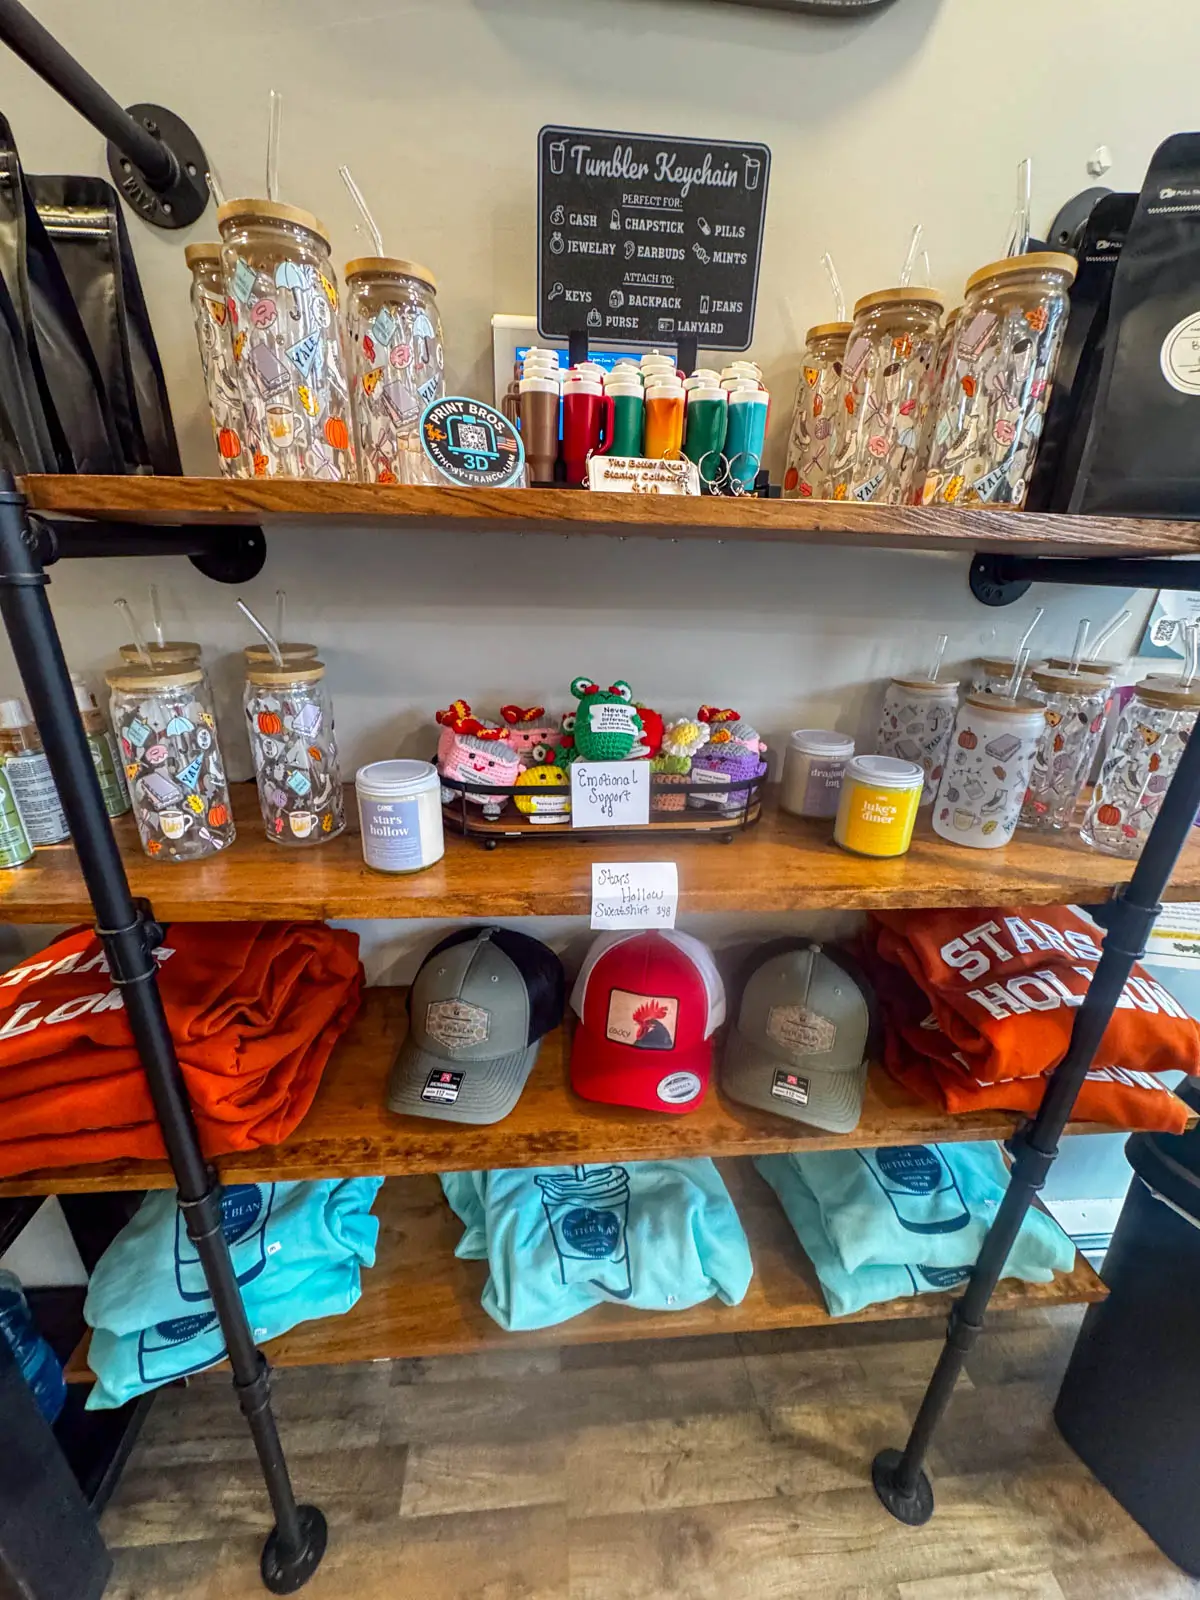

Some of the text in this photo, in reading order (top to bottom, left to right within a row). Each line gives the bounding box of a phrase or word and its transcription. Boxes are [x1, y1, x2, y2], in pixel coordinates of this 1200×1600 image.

[570, 144, 738, 198] Tumbler Keychain
[622, 193, 683, 208] PERFECT FOR:
[569, 213, 597, 227] CASH
[625, 217, 684, 234] CHAPSTICK
[714, 224, 746, 238] PILLS
[567, 239, 616, 256] JEWELRY
[637, 246, 685, 261] EARBUDS
[713, 251, 747, 265] MINTS
[624, 272, 674, 285] ATTACH TO:
[565, 290, 592, 303] KEYS
[628, 294, 682, 309] BACKPACK
[712, 300, 743, 313] JEANS
[606, 315, 639, 329] PURSE
[677, 321, 724, 334] LANYARD
[292, 336, 316, 367] YALE
[429, 402, 505, 433] PRINT BROS.
[463, 454, 489, 471] 3D
[609, 458, 626, 468] The
[857, 474, 881, 501] YALE
[977, 464, 1010, 496] YALE
[603, 706, 628, 714] Never
[181, 758, 202, 784] YALE
[577, 768, 638, 788] Emotional
[589, 787, 632, 808] Support
[862, 801, 897, 817] luke's
[372, 815, 403, 825] stars
[862, 812, 896, 825] diner
[369, 824, 410, 837] hollow
[598, 869, 630, 886] Stars
[621, 886, 664, 903] Hollow
[594, 902, 650, 918] Sweatshirt
[940, 915, 1103, 982] STARS
[221, 1199, 233, 1208] HE
[231, 1202, 260, 1218] BEAN
